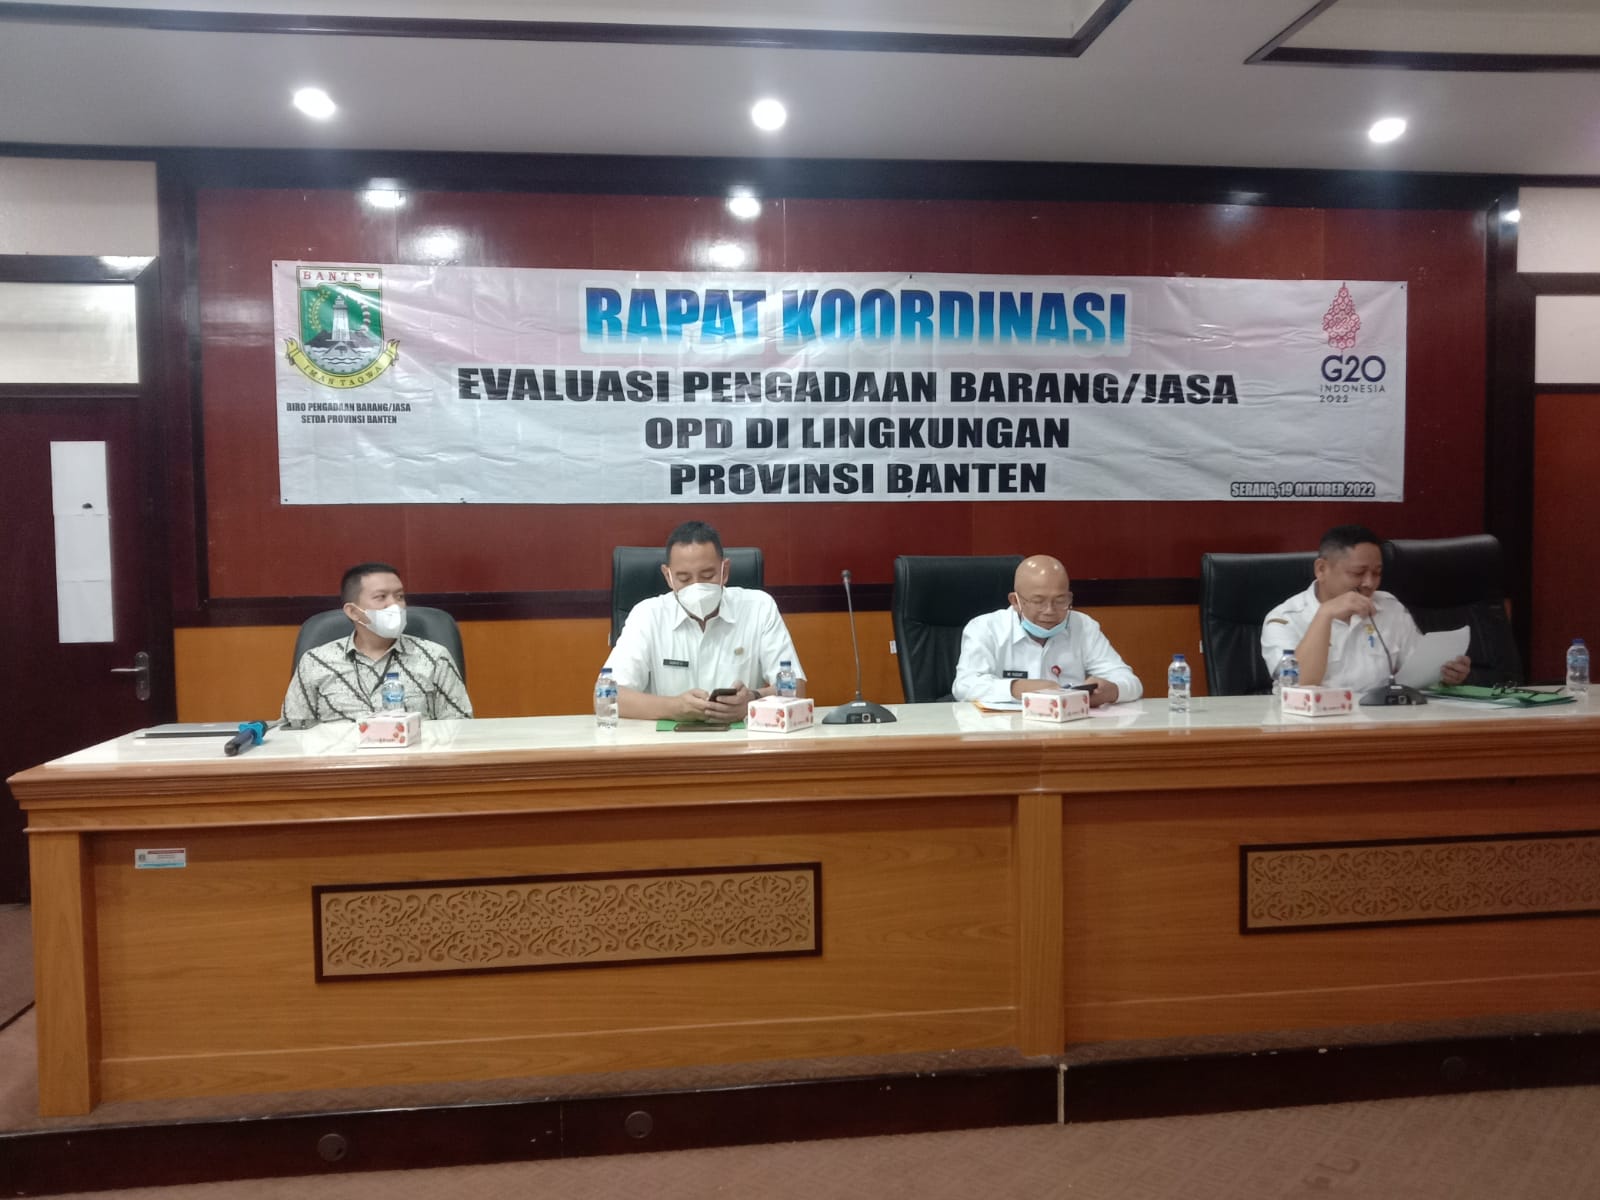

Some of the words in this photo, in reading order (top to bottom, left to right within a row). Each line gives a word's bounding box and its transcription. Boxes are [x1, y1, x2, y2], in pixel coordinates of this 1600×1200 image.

[585, 287, 766, 346] RAPAT
[782, 288, 1126, 348] KOORDINASI
[1321, 355, 1386, 383] G20
[457, 367, 670, 402] EVALUASI
[683, 371, 937, 403] PENGADAAN
[950, 371, 1239, 404] BARANG/JASA
[1320, 384, 1386, 393] INDONESIA
[286, 402, 306, 412] BIRO
[308, 402, 355, 412] PENGADAAN
[356, 402, 411, 412] BARANG/JASA
[1319, 395, 1349, 403] 2022
[301, 414, 326, 424] SETDA
[327, 414, 365, 424] PROVINSI
[367, 414, 397, 424] BANTEN
[645, 417, 733, 449] OPD
[746, 417, 789, 449] DI
[802, 417, 1070, 449] LINGKUNGAN
[670, 463, 874, 495] PROVINSI
[887, 463, 1047, 493] BANTEN
[1279, 482, 1294, 497] 19
[1294, 482, 1345, 497] OKTOBER
[1345, 482, 1375, 497] 2022
